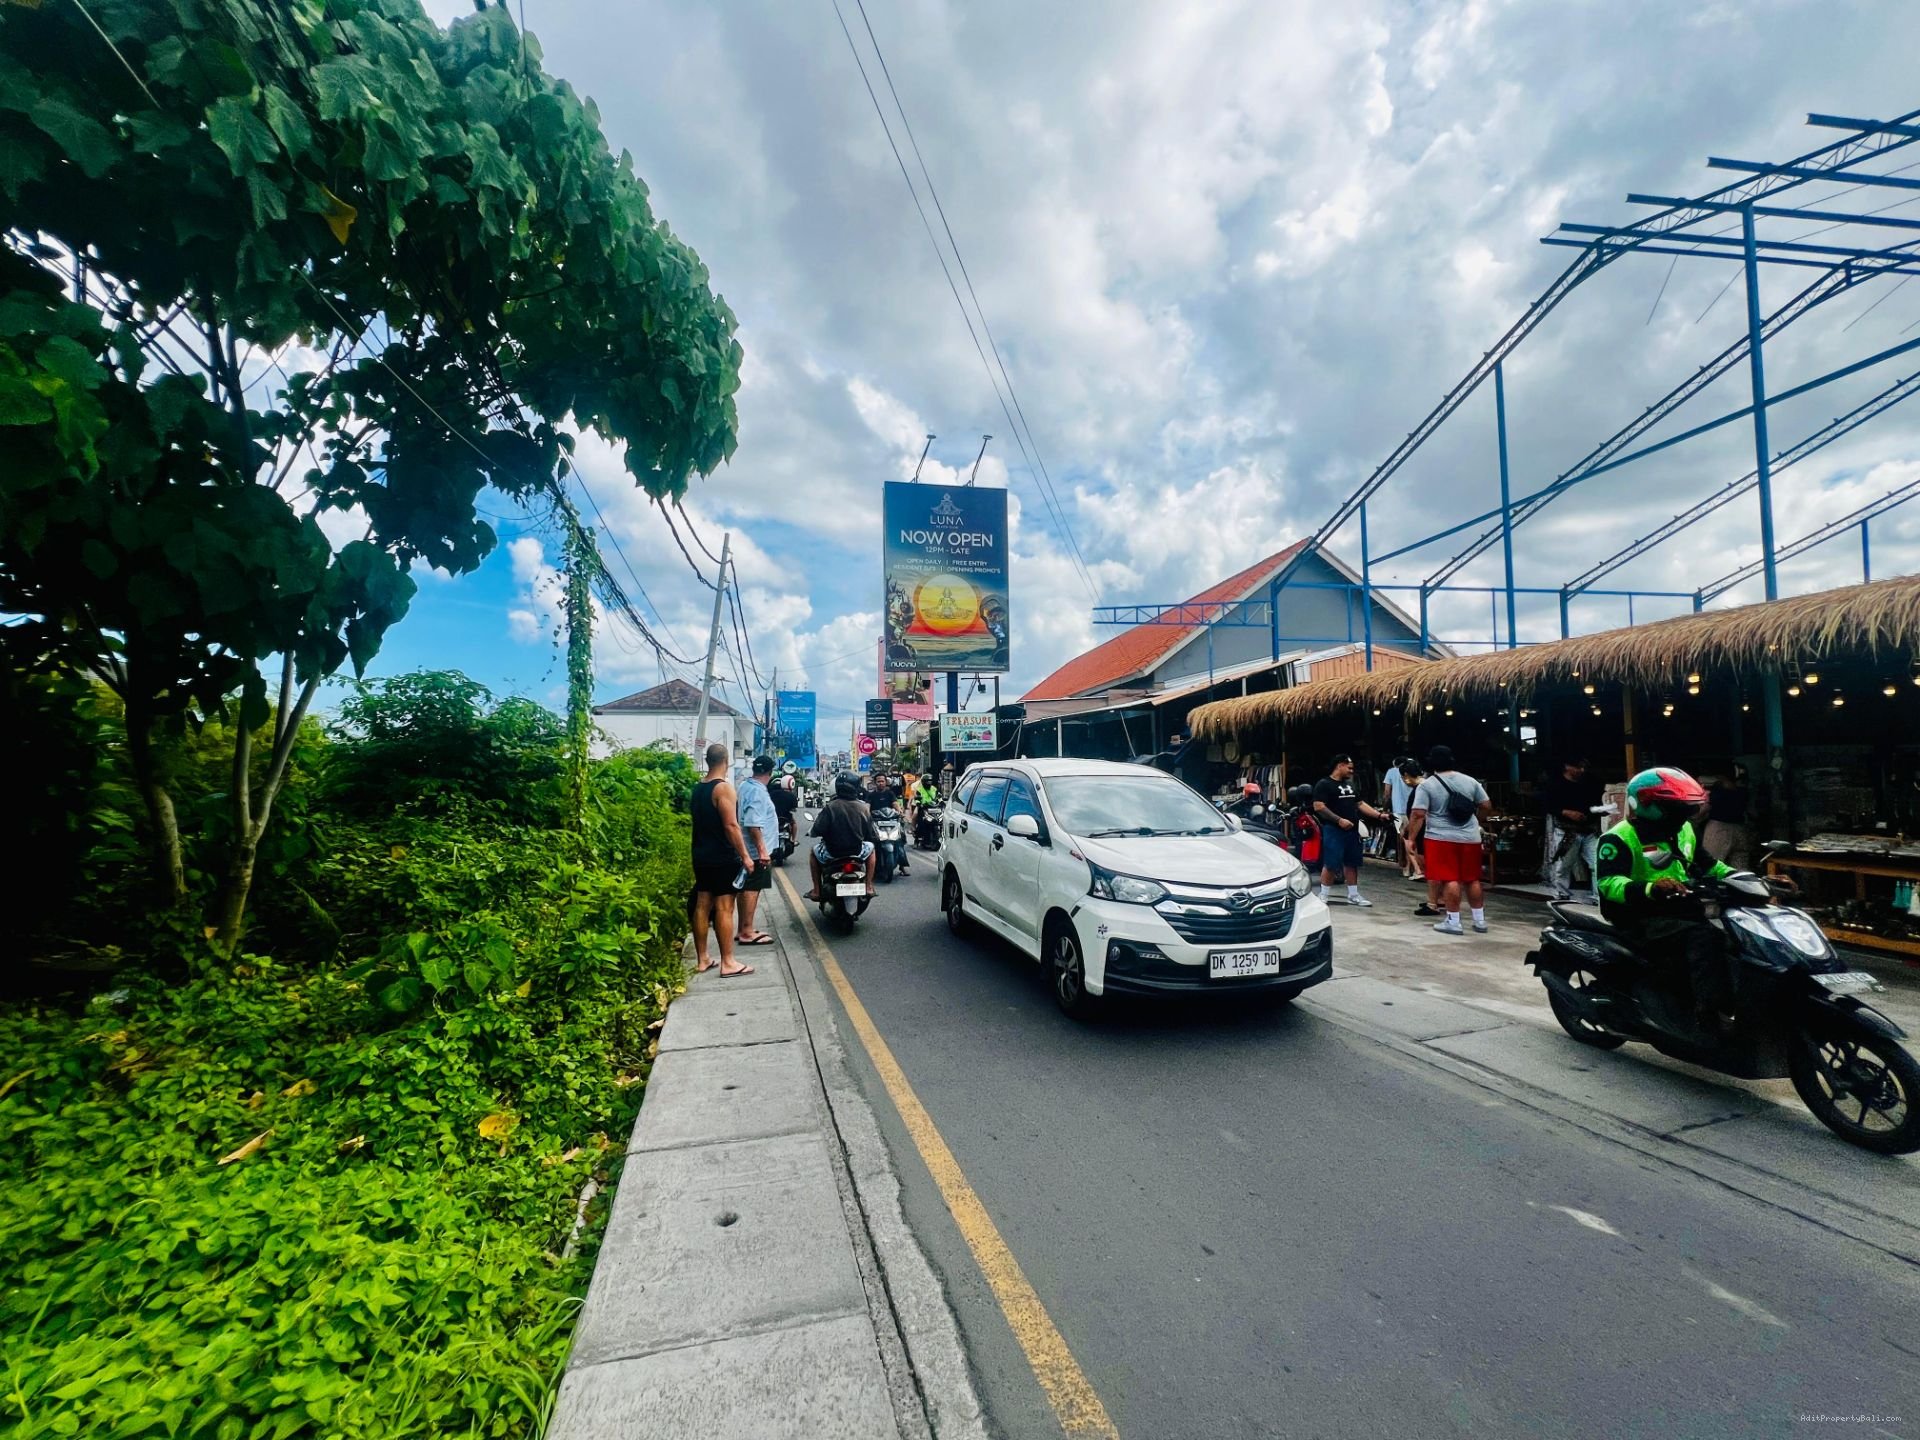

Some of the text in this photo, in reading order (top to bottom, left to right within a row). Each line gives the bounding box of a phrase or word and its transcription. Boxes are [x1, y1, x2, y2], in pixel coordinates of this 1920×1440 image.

[930, 515, 964, 526] LUNA
[900, 529, 993, 547] NOW OPEN
[925, 546, 944, 554] 12PM
[950, 547, 970, 555] LATE
[946, 716, 992, 725] TREASURE
[1212, 952, 1277, 970] DK 1259 DO
